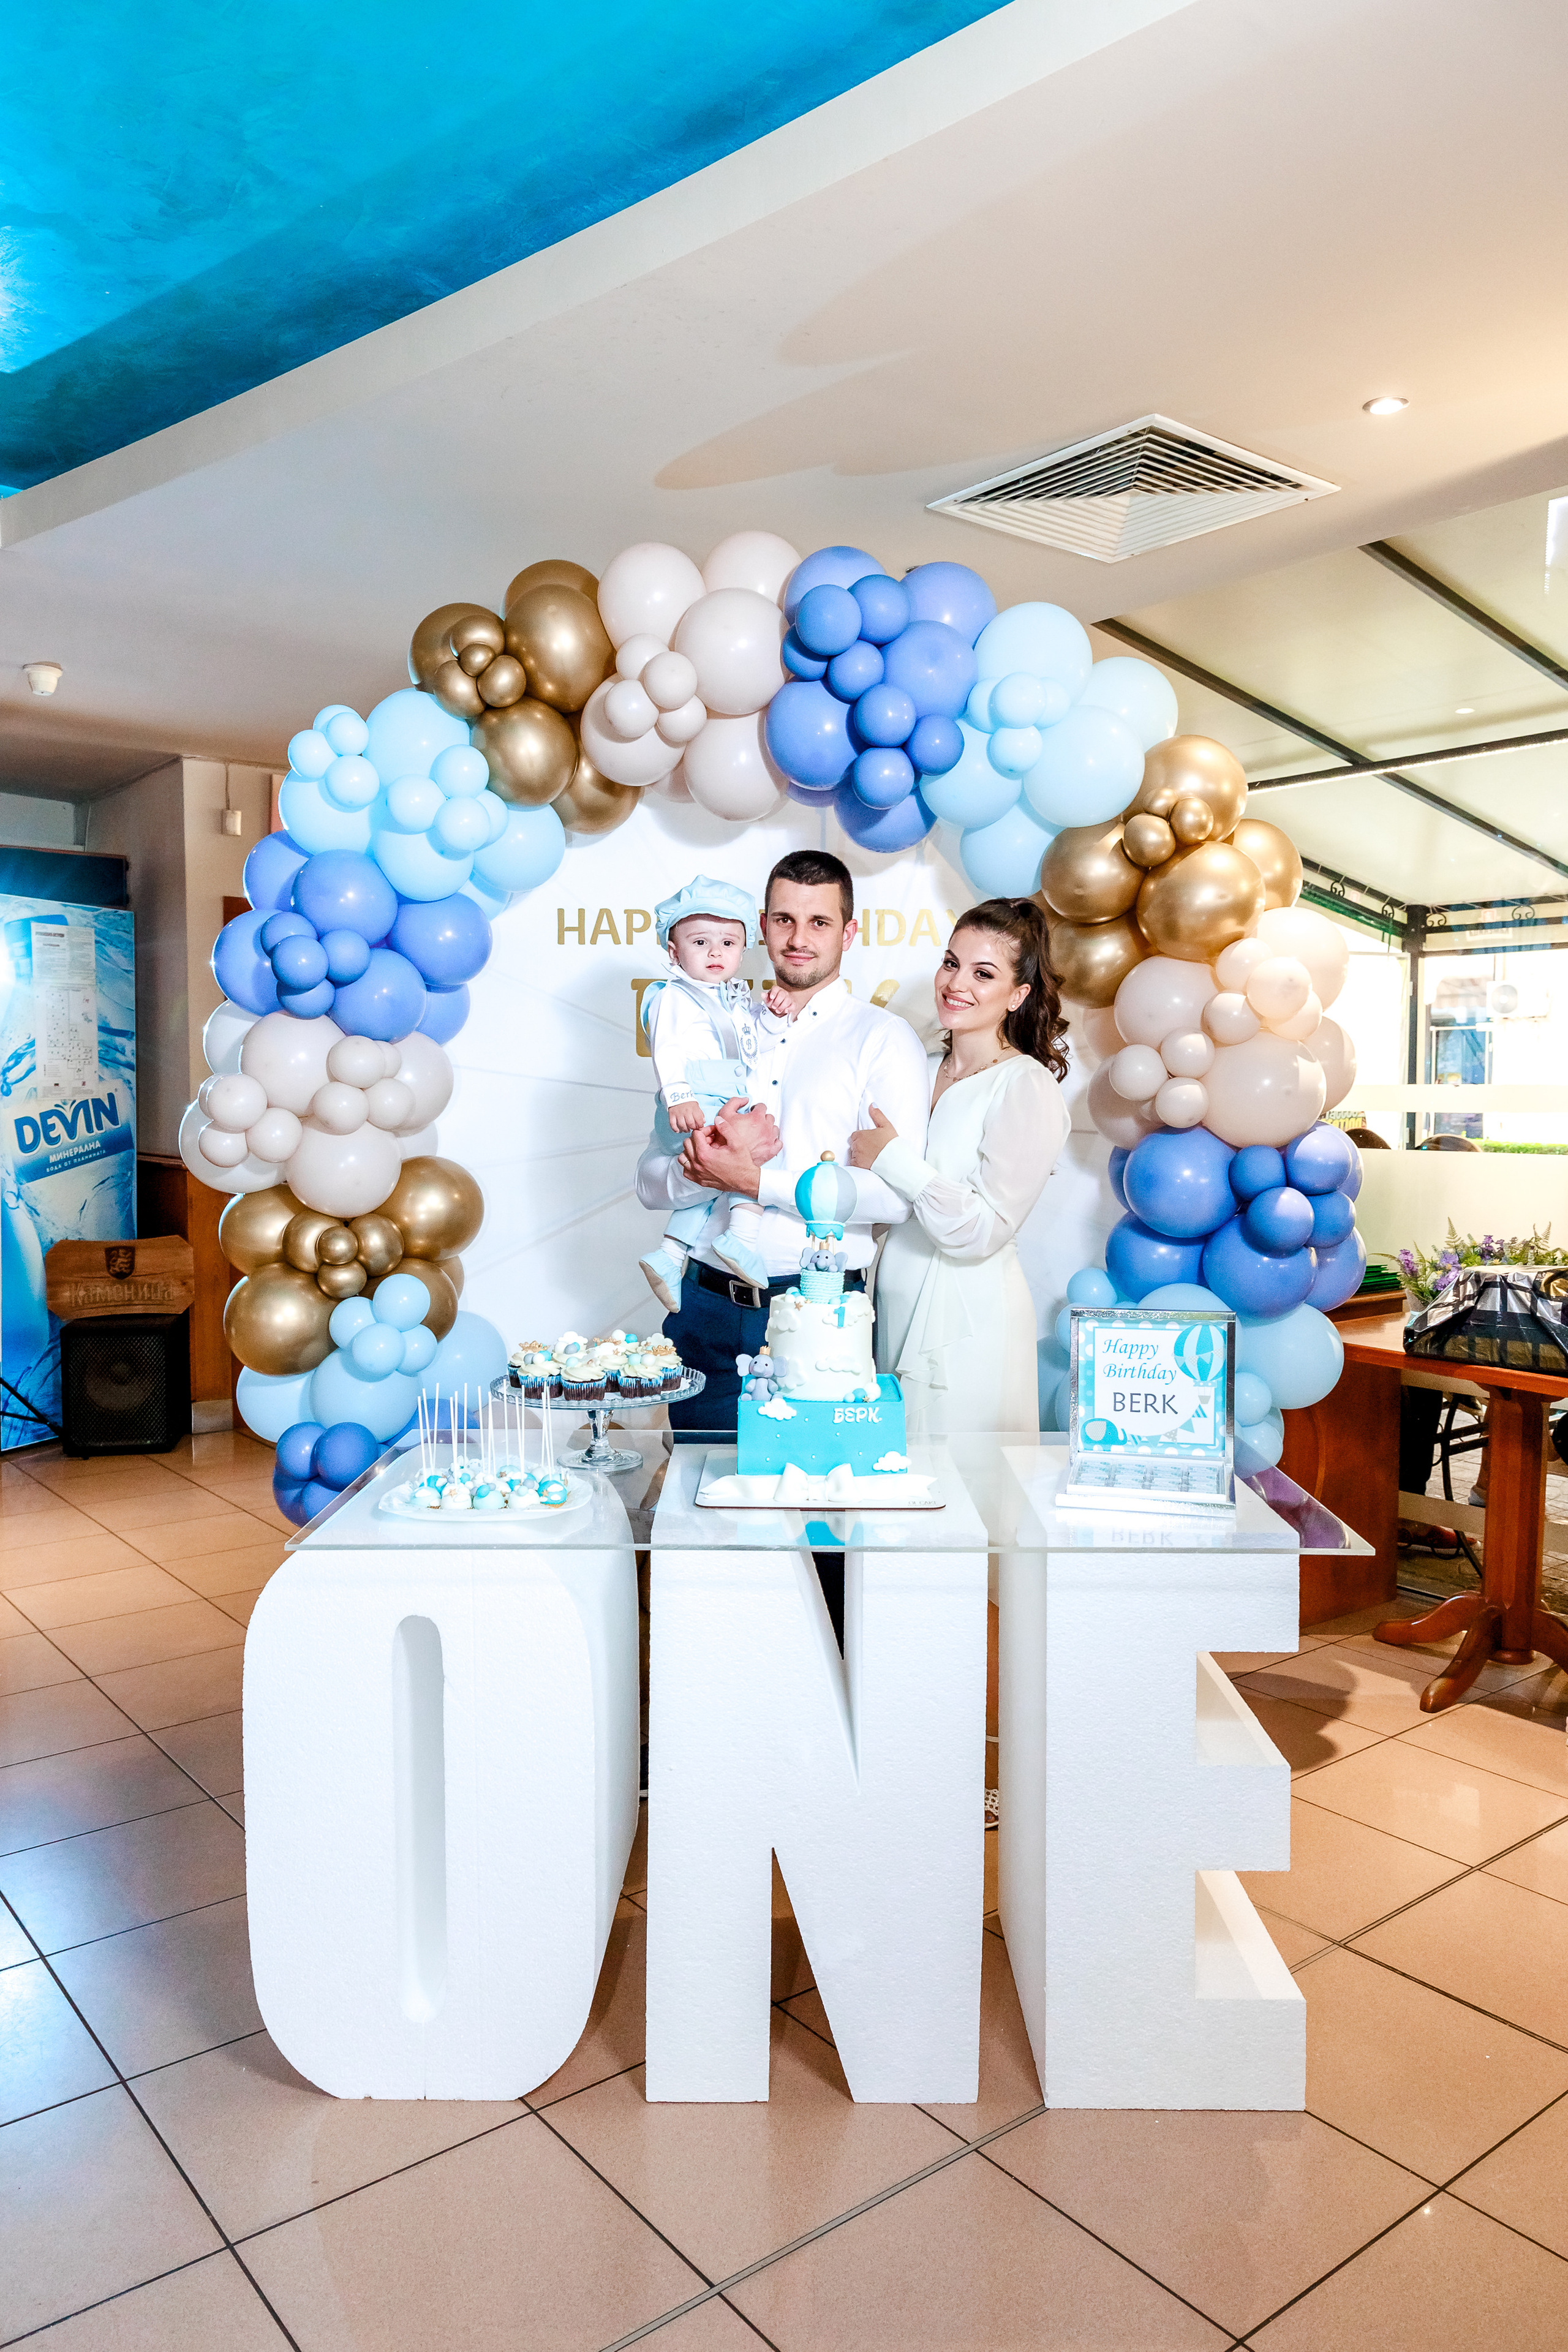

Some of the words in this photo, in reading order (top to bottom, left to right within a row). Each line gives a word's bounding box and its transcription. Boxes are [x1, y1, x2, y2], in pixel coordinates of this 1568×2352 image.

[557, 908, 662, 945] HAP
[670, 1090, 696, 1102] Berk
[14, 1092, 119, 1154] DEVIN
[50, 1140, 101, 1163] МИНЕРАЛНА
[834, 1306, 845, 1327] 1
[1102, 1338, 1159, 1360] Happy
[1103, 1362, 1177, 1385] Birthday
[1113, 1392, 1178, 1414] BERK
[243, 1547, 1306, 2111] ONE
